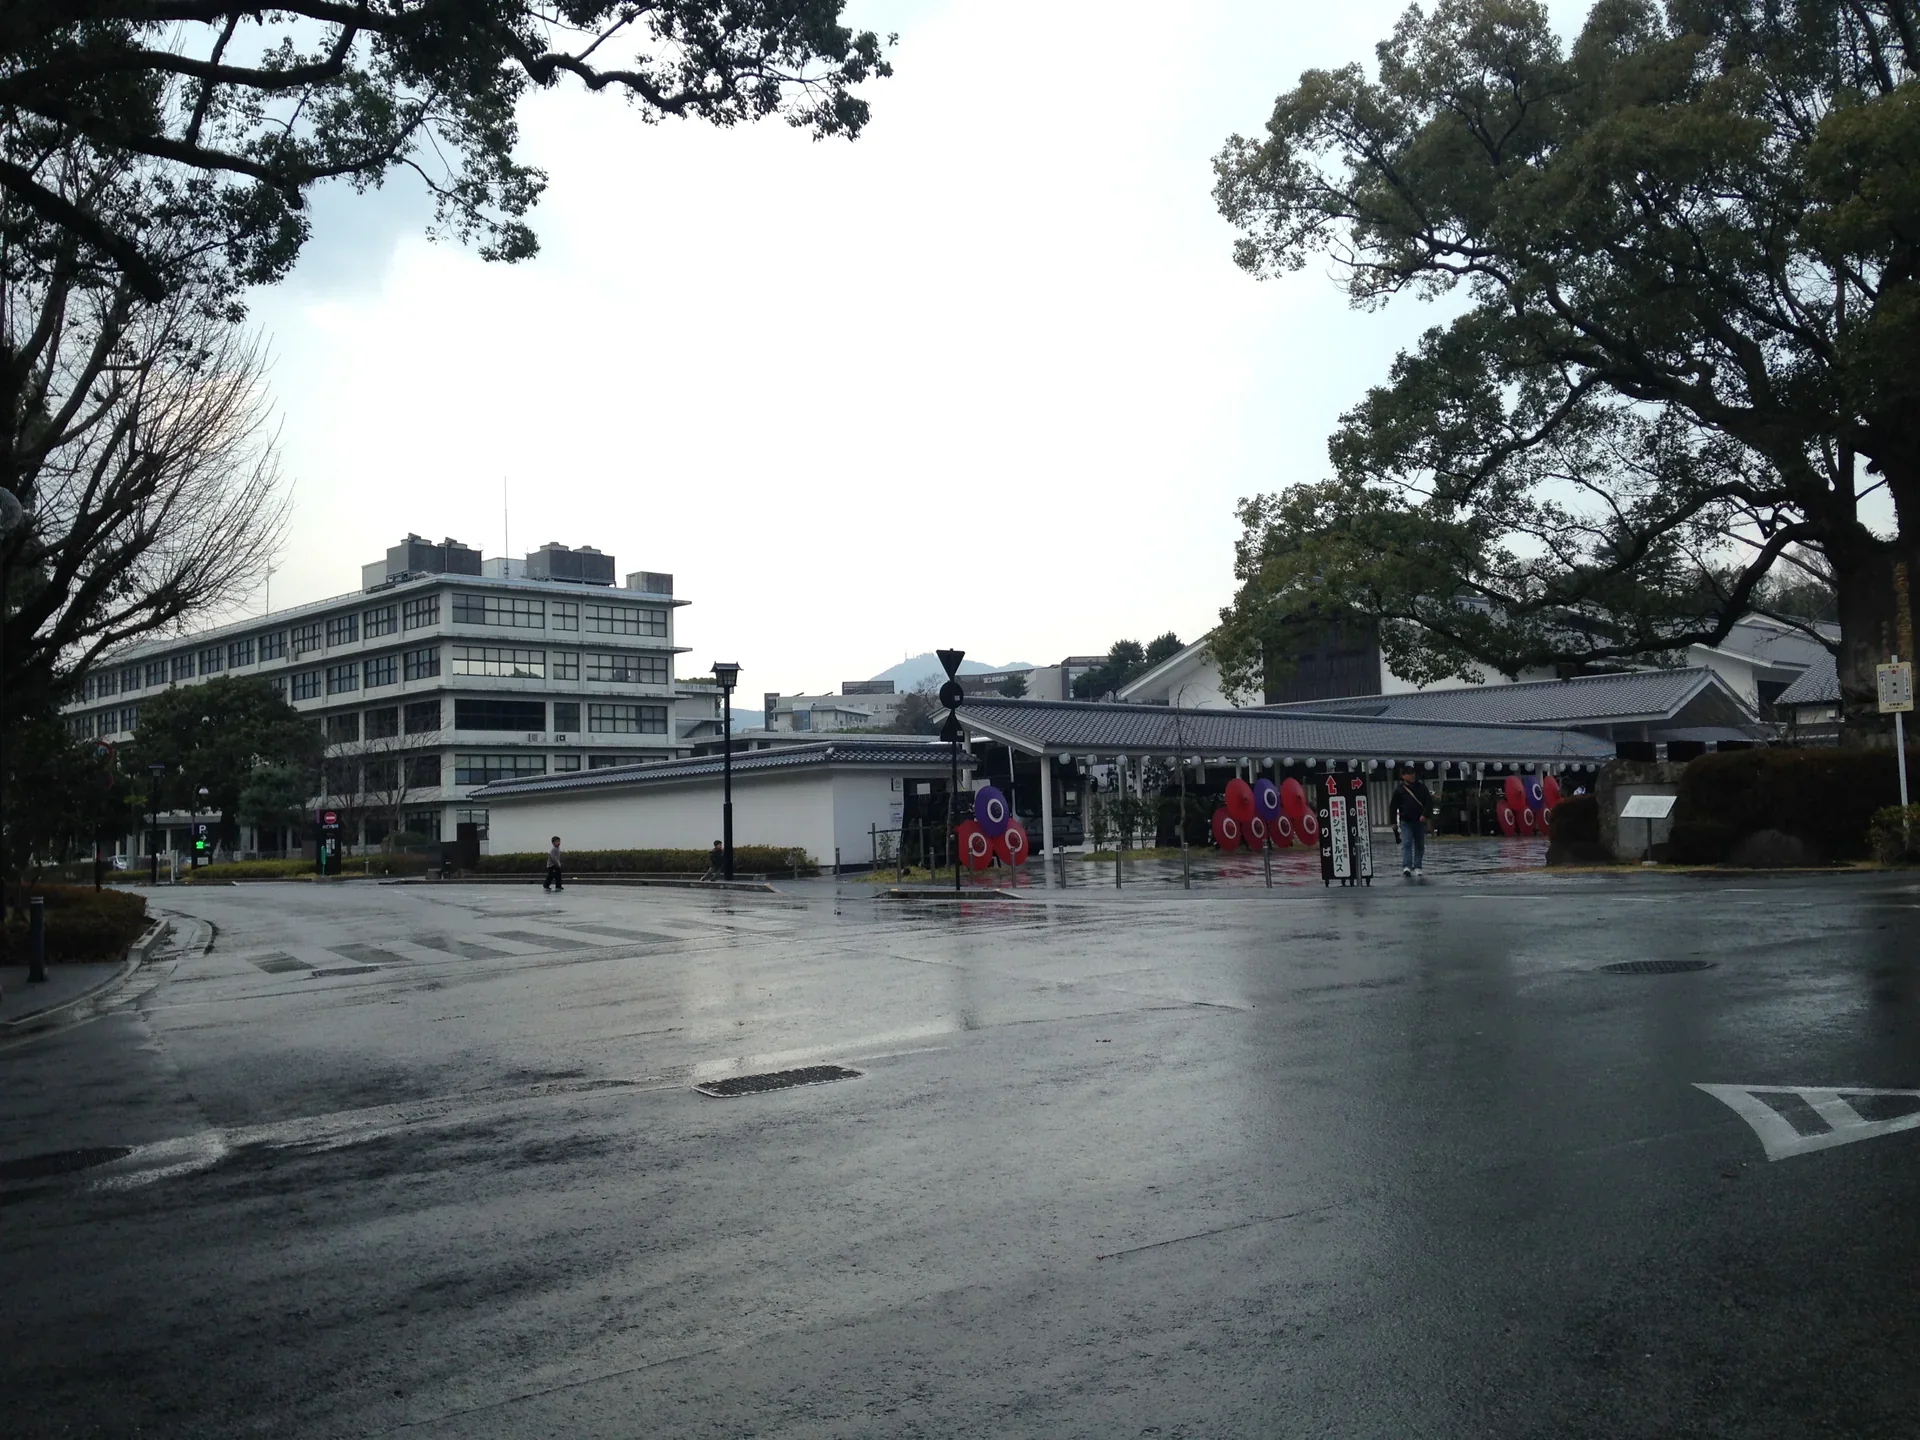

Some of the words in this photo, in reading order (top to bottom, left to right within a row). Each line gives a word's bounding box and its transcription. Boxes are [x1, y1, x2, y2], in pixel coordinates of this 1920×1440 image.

[199, 824, 207, 834] P
[1319, 808, 1331, 858] のりば
